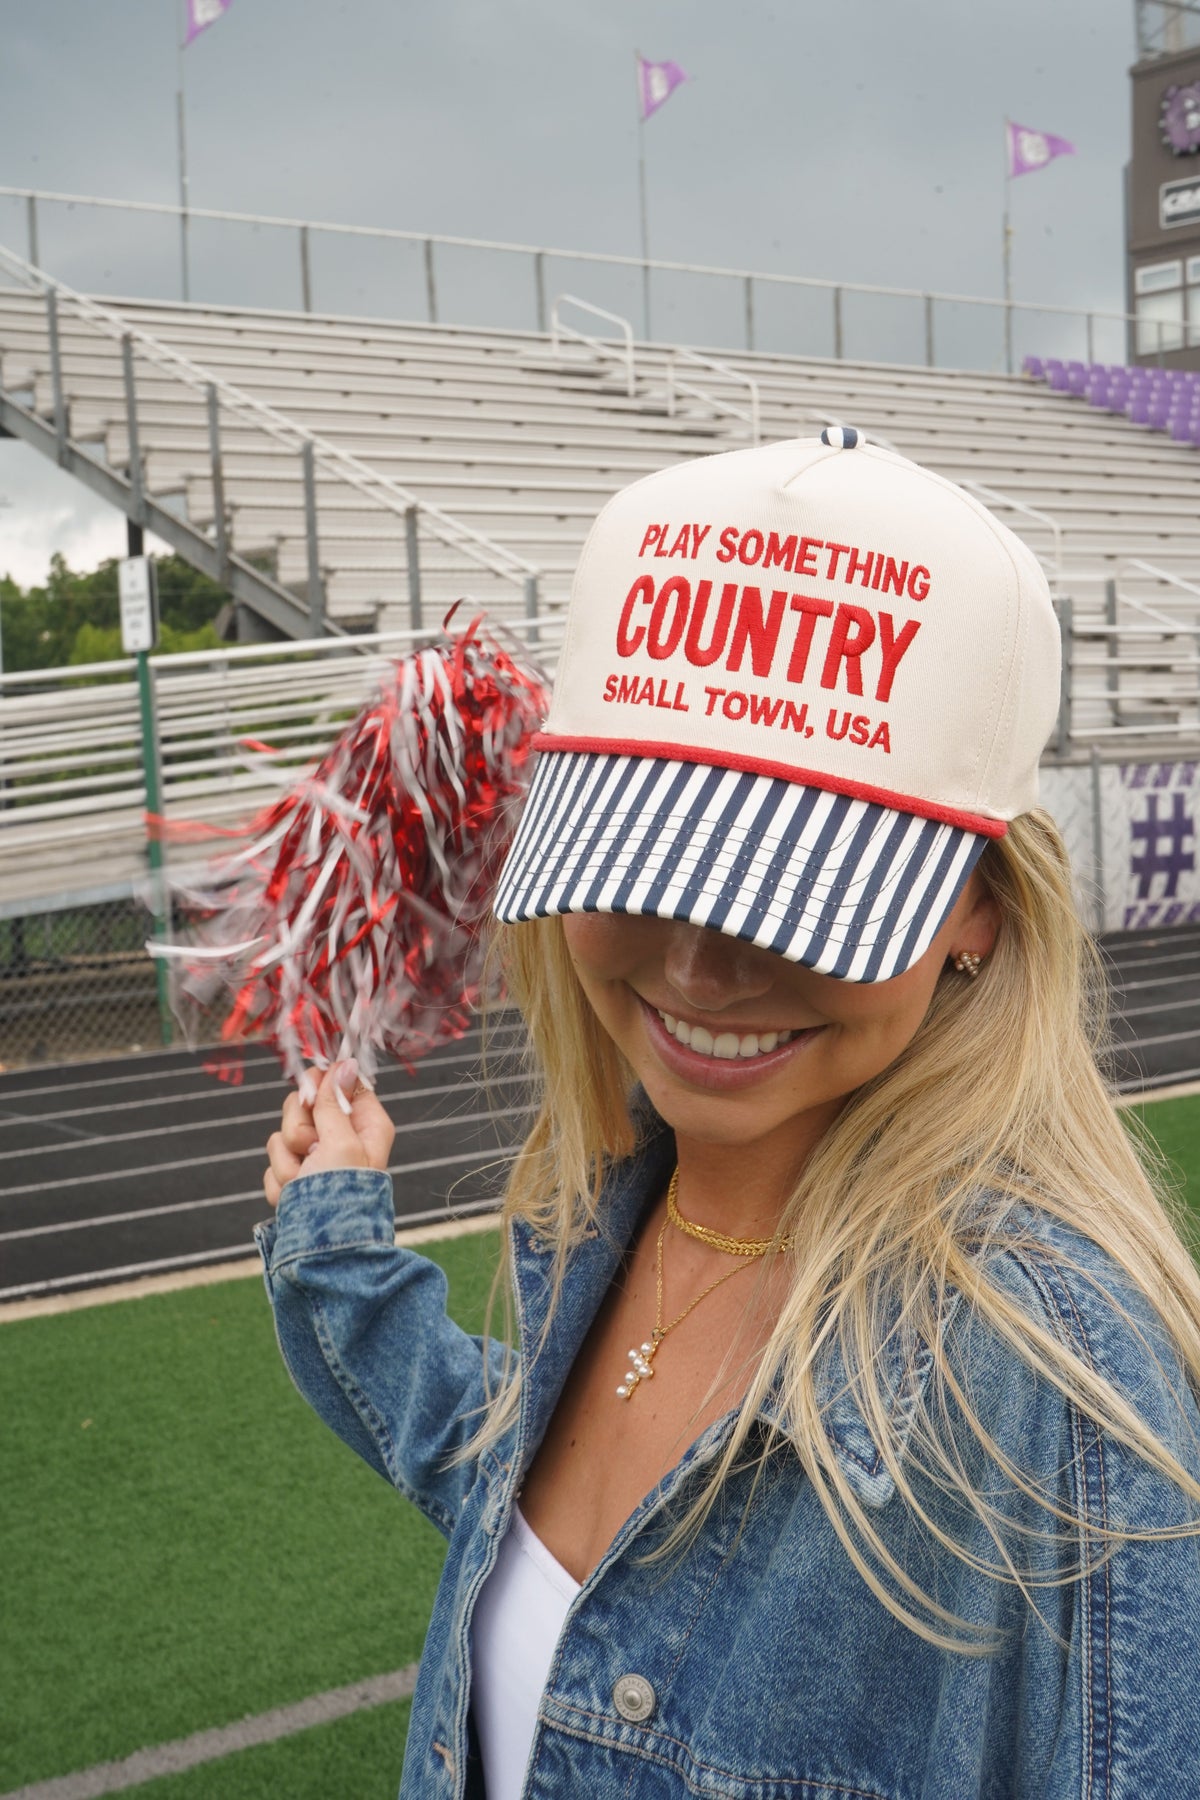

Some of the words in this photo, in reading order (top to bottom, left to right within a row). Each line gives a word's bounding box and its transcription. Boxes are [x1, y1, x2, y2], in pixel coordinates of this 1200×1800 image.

[639, 524, 711, 559] PLAY
[717, 527, 931, 602] SOMETHING
[616, 575, 922, 703] COUNTRY
[603, 674, 689, 712] SMALL
[704, 687, 814, 739] TOWN,
[826, 709, 891, 754] USA
